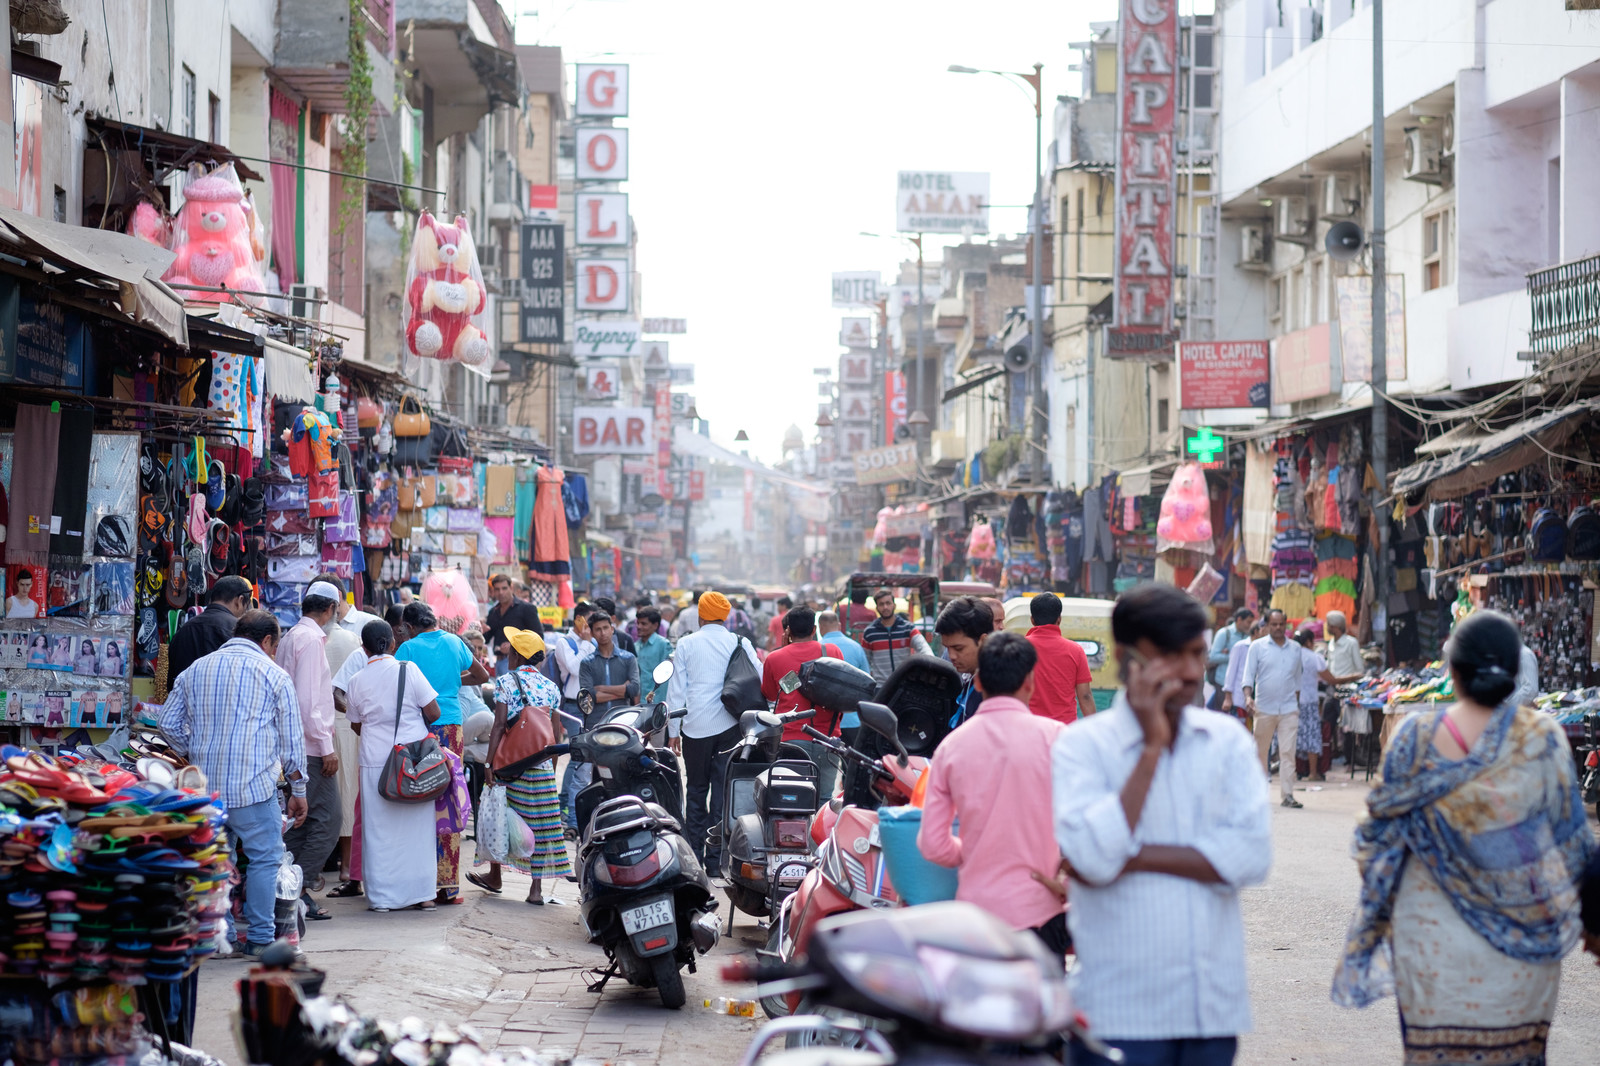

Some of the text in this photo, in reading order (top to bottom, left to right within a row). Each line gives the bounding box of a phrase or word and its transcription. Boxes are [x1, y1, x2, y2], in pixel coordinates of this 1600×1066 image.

[585, 69, 619, 304] GOLD
[899, 174, 955, 191] HOTEL
[904, 192, 984, 215] AMAN
[530, 228, 556, 250] AAA
[531, 257, 554, 279] 925
[523, 287, 562, 309] SILVER
[832, 278, 879, 301] HOTEL
[526, 316, 558, 338] INDIA
[643, 318, 687, 333] HOTEL
[576, 326, 638, 352] Regency
[1183, 343, 1265, 360] HOTEL CAPITAL
[55, 356, 68, 373] PAAR
[1194, 359, 1253, 369] RESIDENCY
[579, 417, 645, 446] BAR
[855, 445, 918, 473] SOBTI
[619, 848, 642, 859] SUZUKI
[633, 911, 670, 931] W7116
